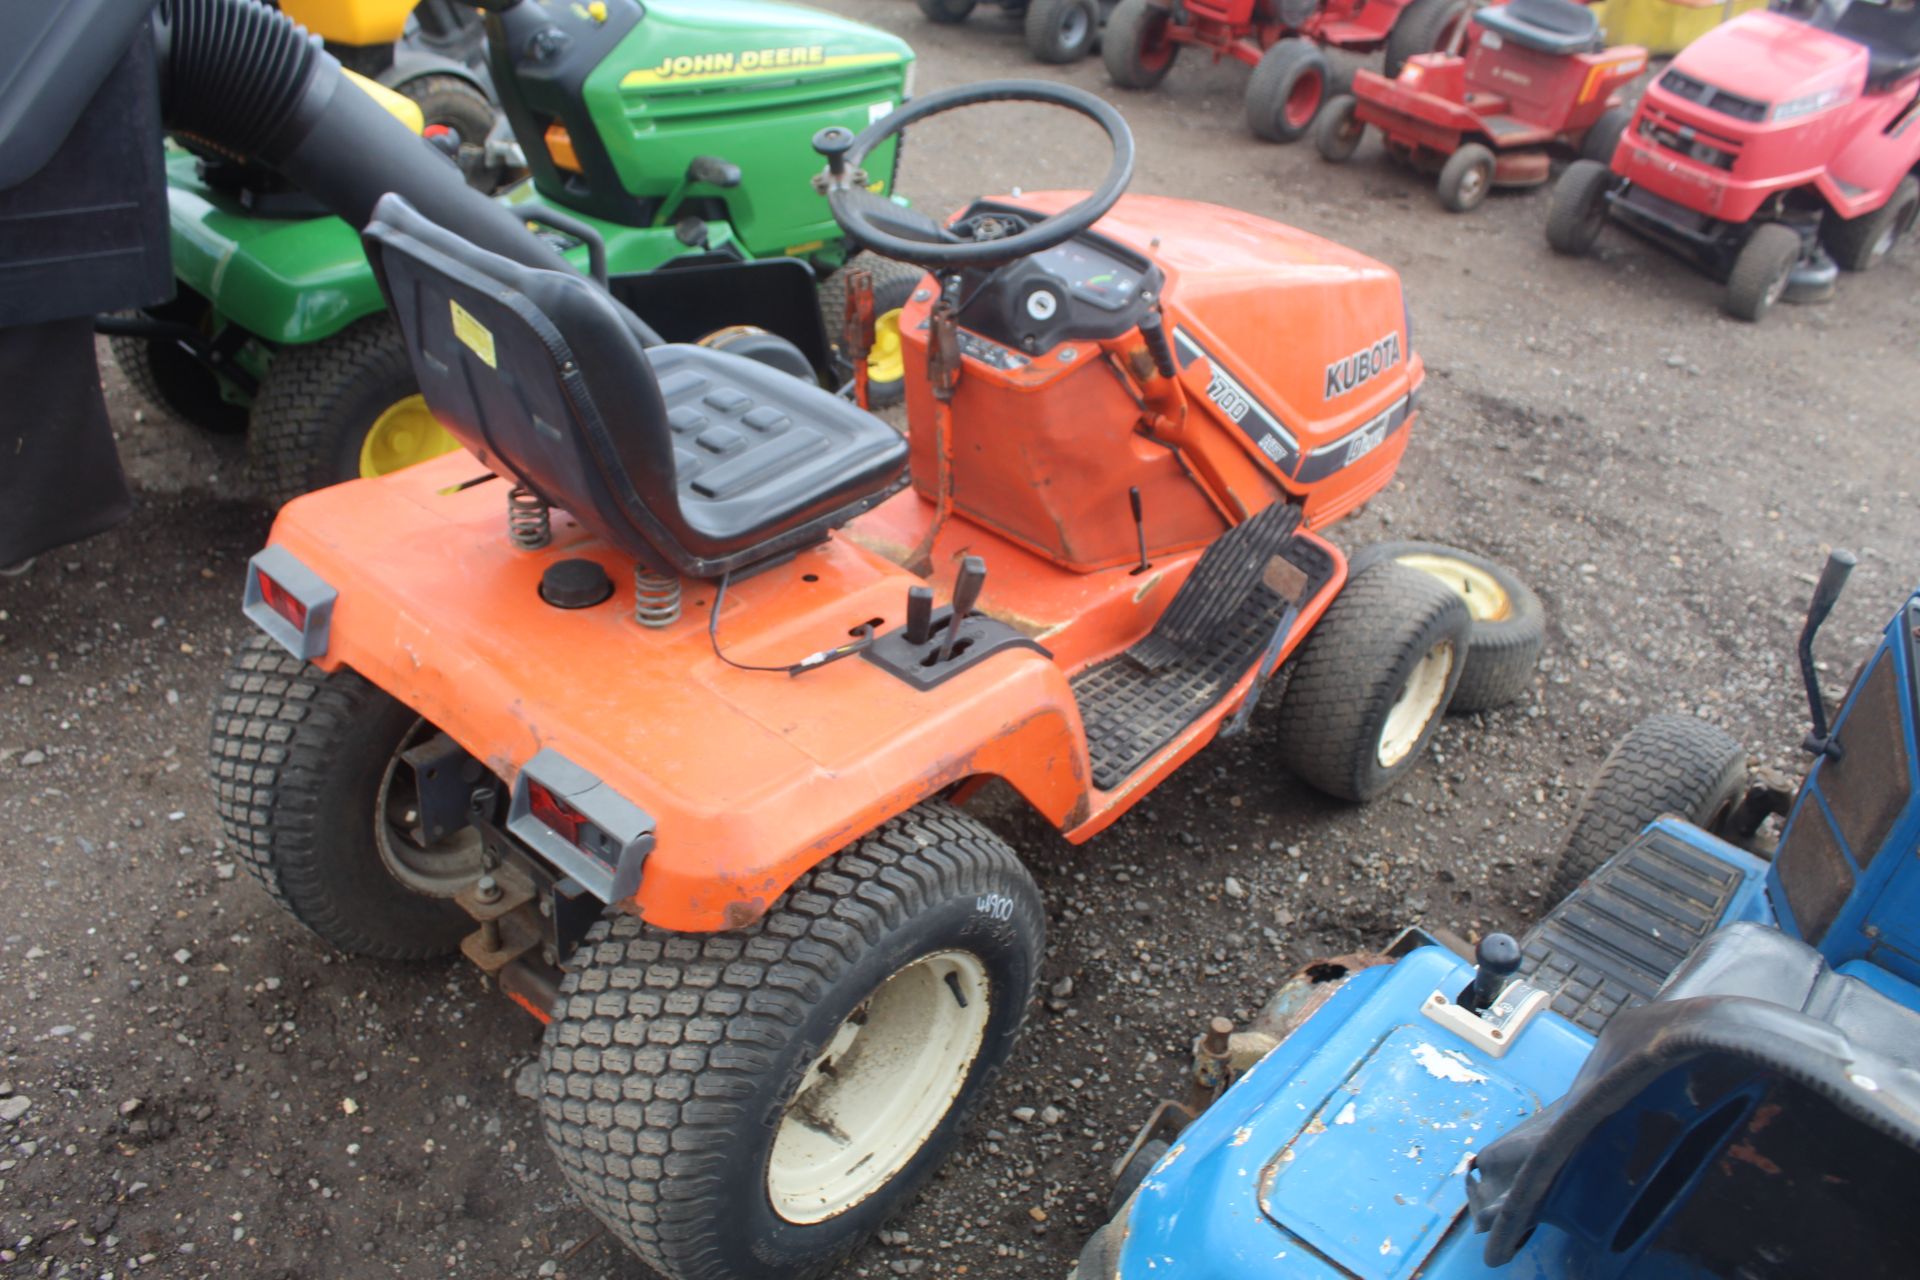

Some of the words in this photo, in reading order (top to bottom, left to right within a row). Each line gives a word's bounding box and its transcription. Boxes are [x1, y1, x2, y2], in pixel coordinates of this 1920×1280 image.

[655, 51, 734, 78] JOHN
[739, 45, 825, 70] DEERE
[1324, 330, 1401, 401] KUBOTA
